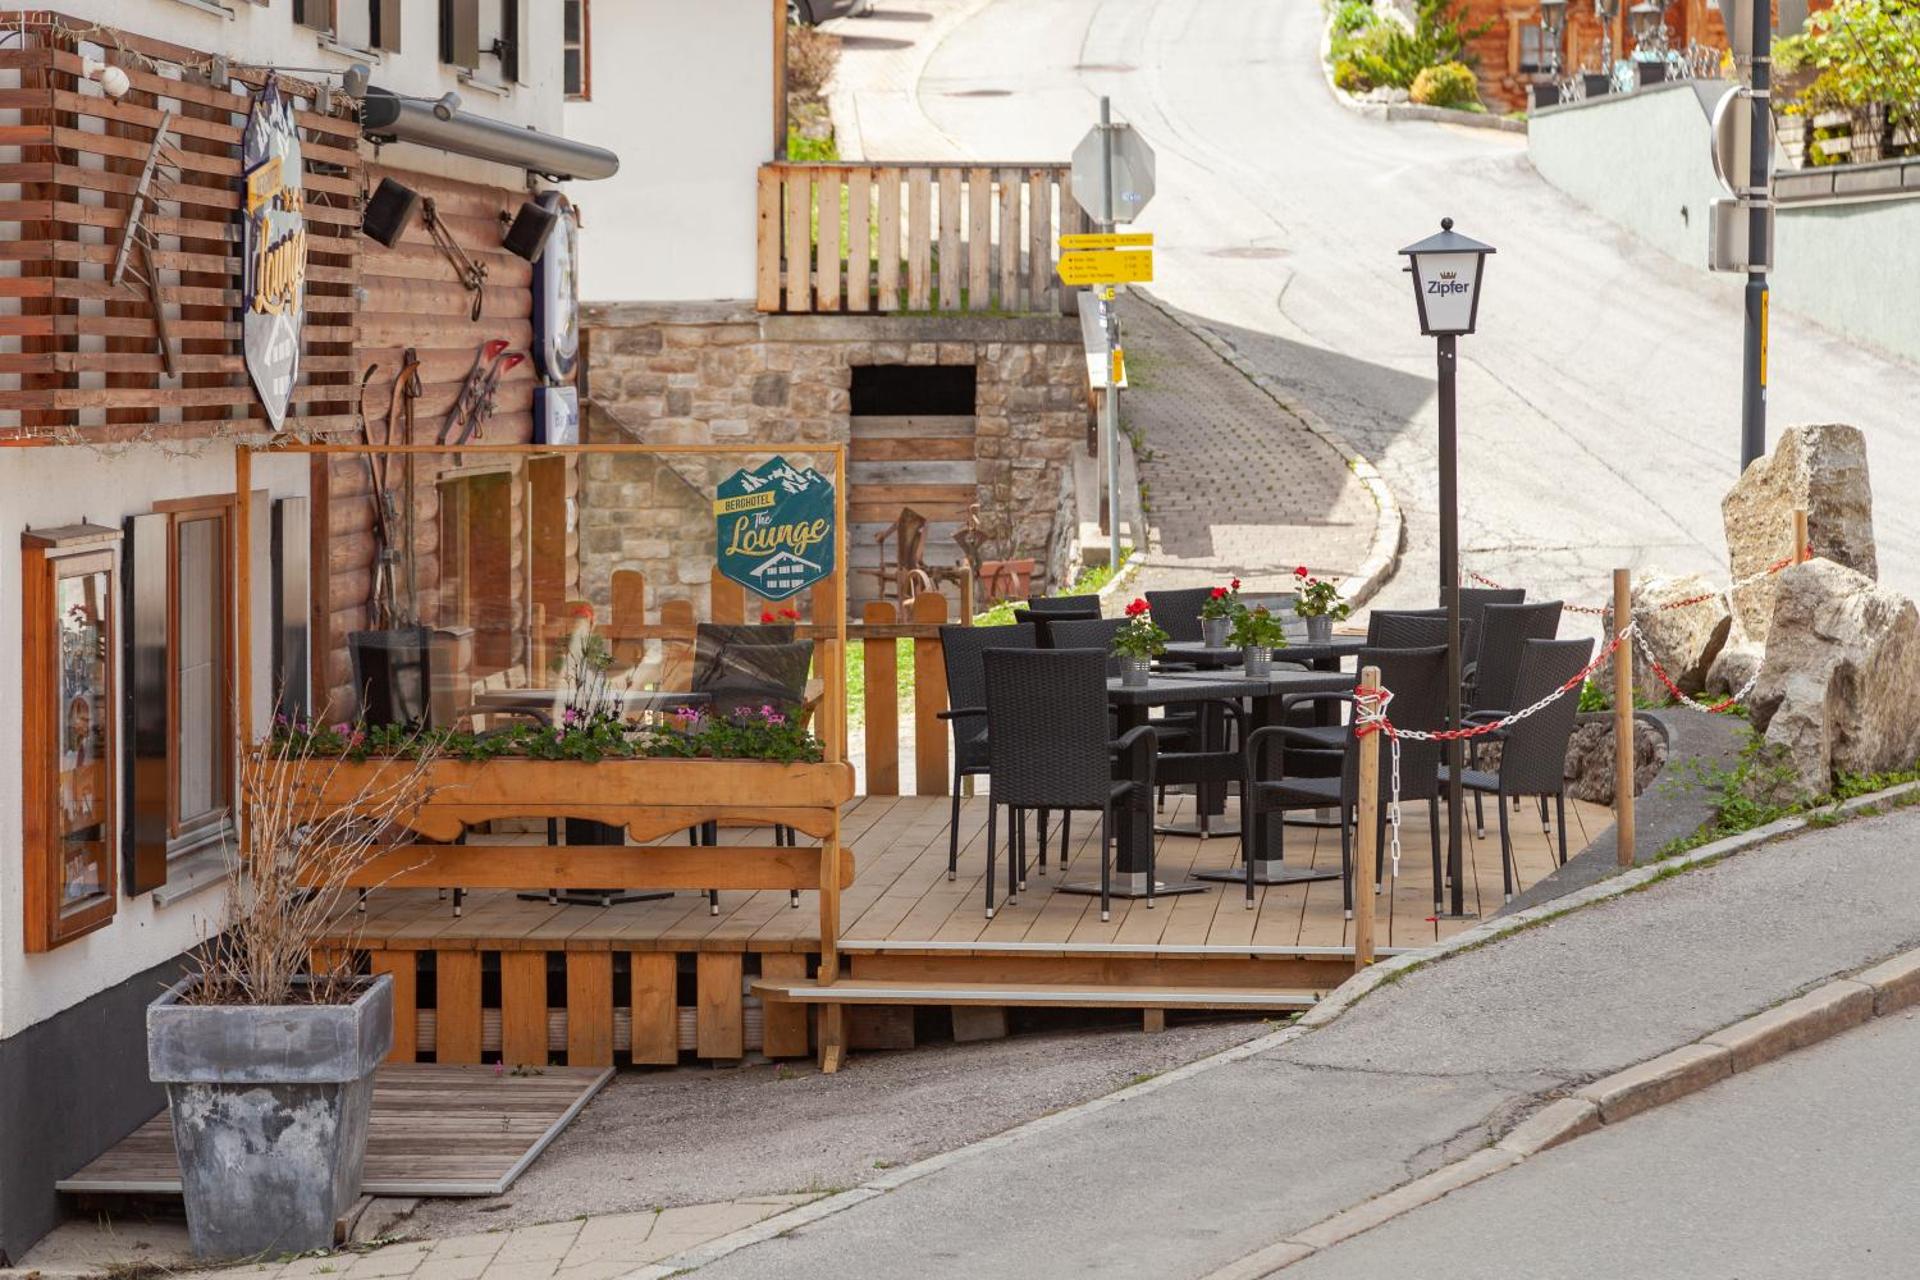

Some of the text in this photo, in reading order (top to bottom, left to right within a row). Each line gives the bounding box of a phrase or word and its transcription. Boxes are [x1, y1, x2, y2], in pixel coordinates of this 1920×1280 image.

[1428, 280, 1469, 297] Zipfer
[725, 493, 770, 511] BERGHOTEL
[751, 510, 772, 529] The
[725, 515, 830, 557] Lounge
